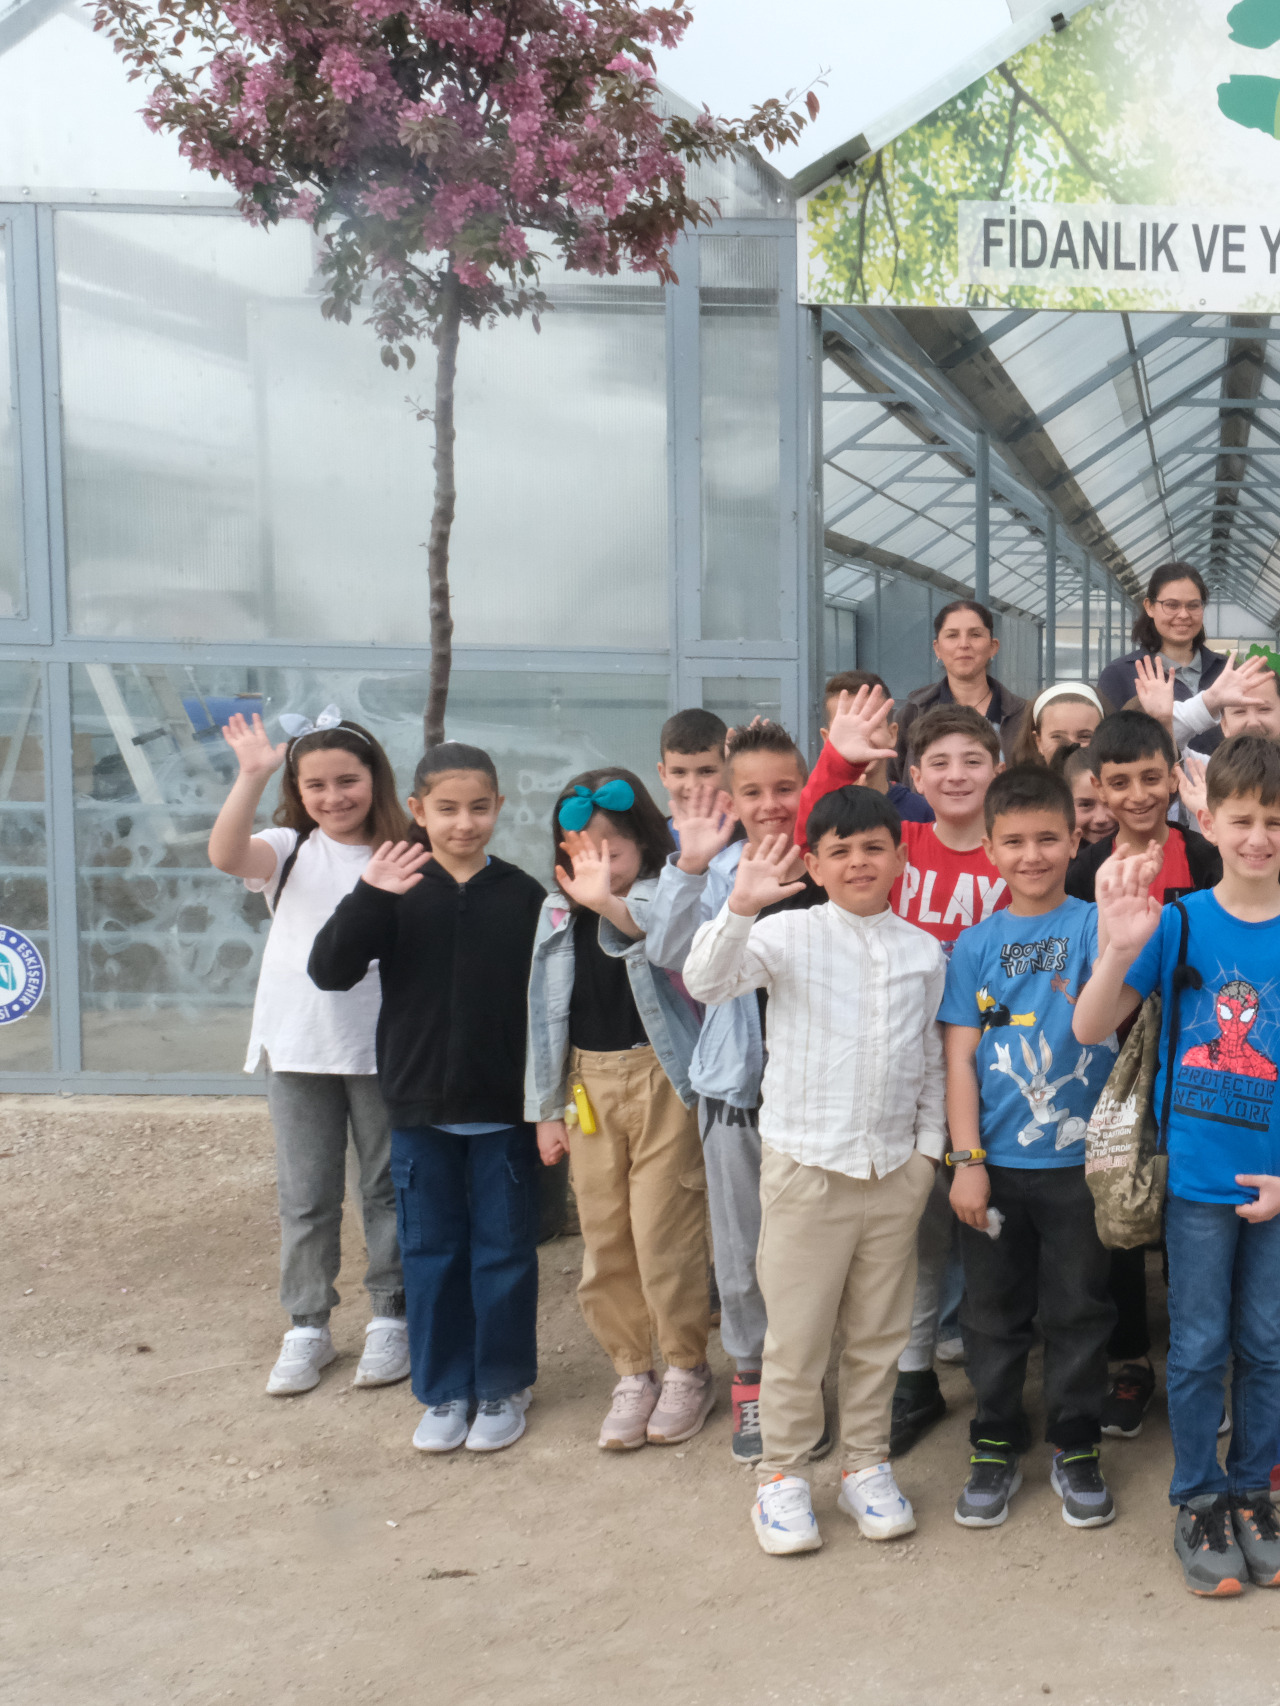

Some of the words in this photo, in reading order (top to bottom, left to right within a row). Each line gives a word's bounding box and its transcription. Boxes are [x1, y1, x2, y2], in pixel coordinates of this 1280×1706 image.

[983, 205, 1180, 273] FİDANLIK
[1191, 223, 1247, 274] VE
[898, 861, 1008, 927] PLAY
[1001, 936, 1070, 960] LOONEY
[16, 942, 41, 1006] ESKİŞEHİR
[1001, 953, 1068, 978] TUNES
[1178, 1066, 1275, 1099] PROTECTOR
[1219, 1090, 1234, 1099] OF
[1173, 1087, 1216, 1111] NEW
[1224, 1098, 1272, 1123] YORK
